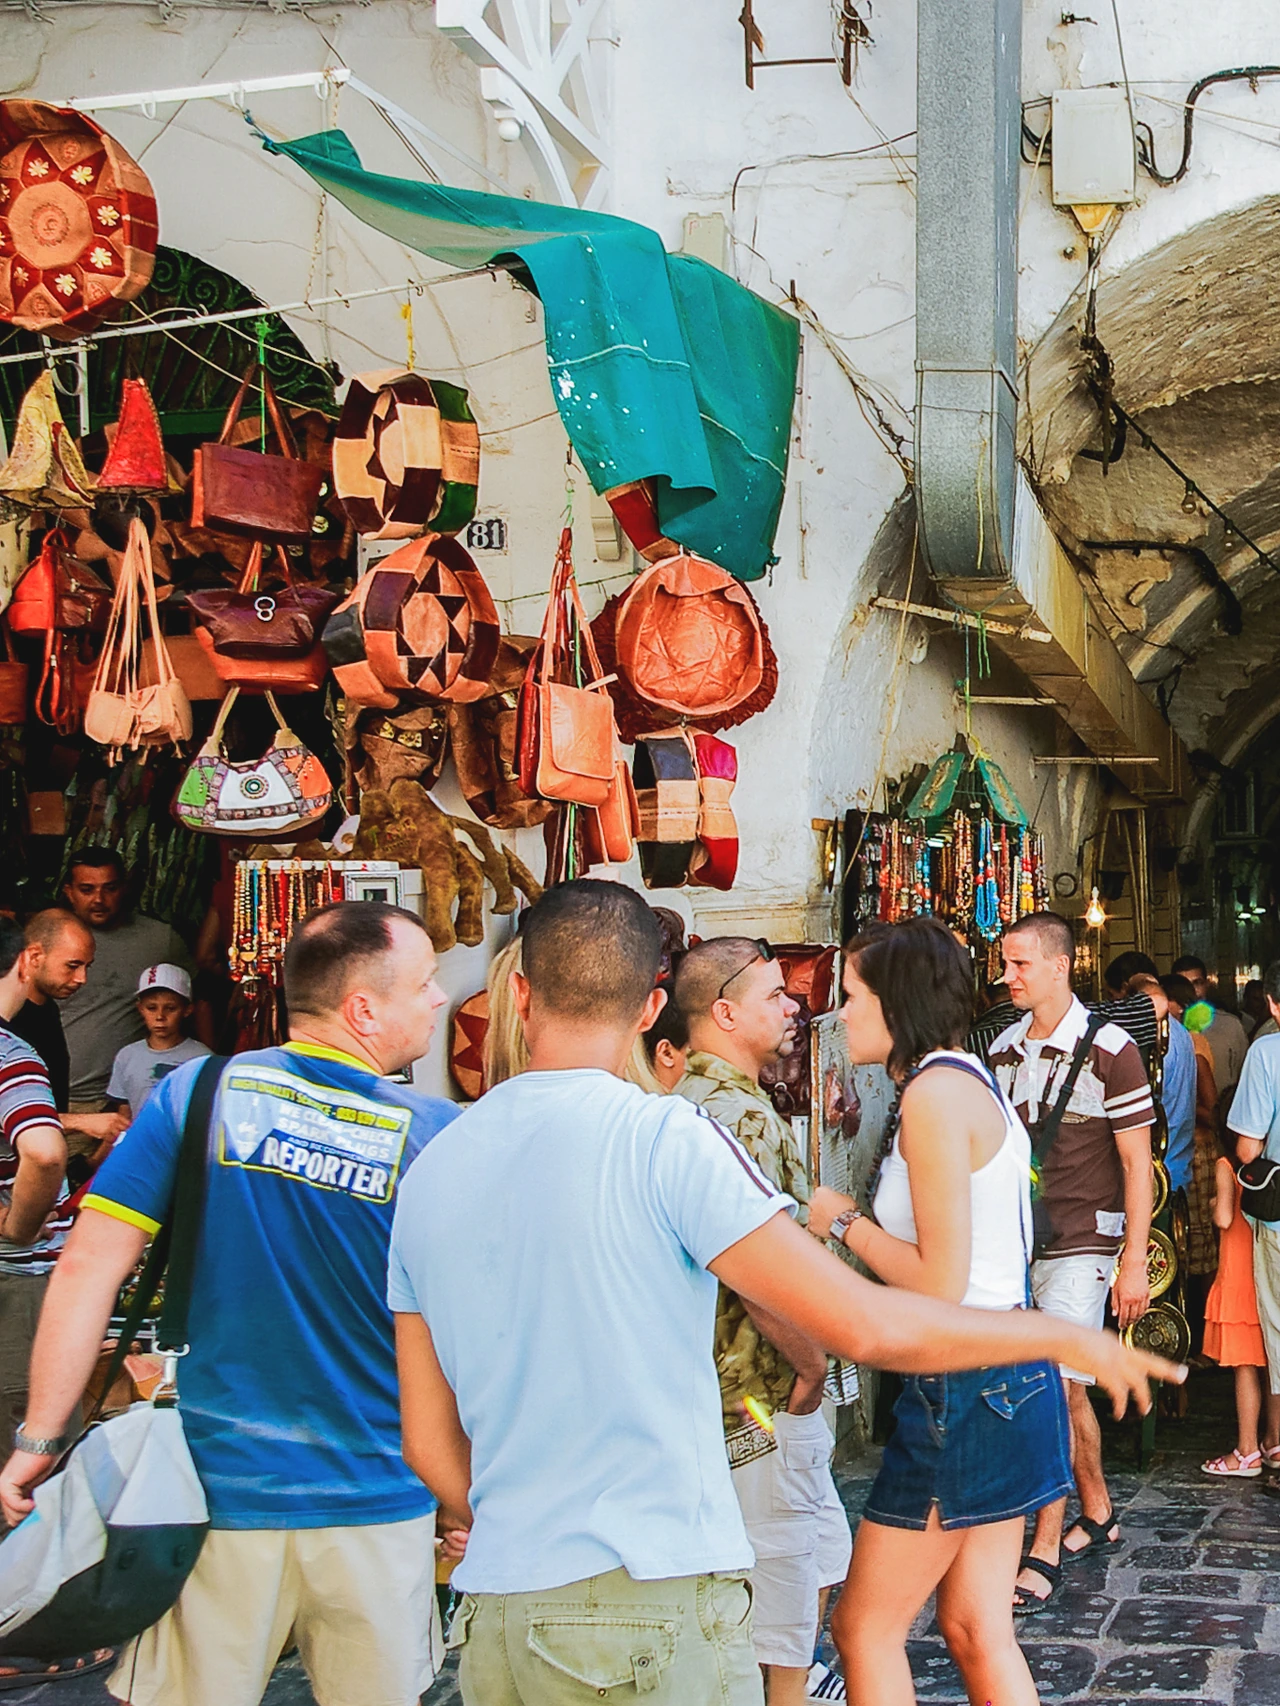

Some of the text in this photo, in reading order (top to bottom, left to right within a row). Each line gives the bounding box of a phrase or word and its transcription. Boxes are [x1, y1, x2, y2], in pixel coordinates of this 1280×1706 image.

[472, 522, 501, 548] 81
[279, 1103, 301, 1119] WE
[275, 1117, 330, 1143] SPARK
[334, 1134, 391, 1160] PLUGS
[261, 1136, 389, 1198] REPORTER
